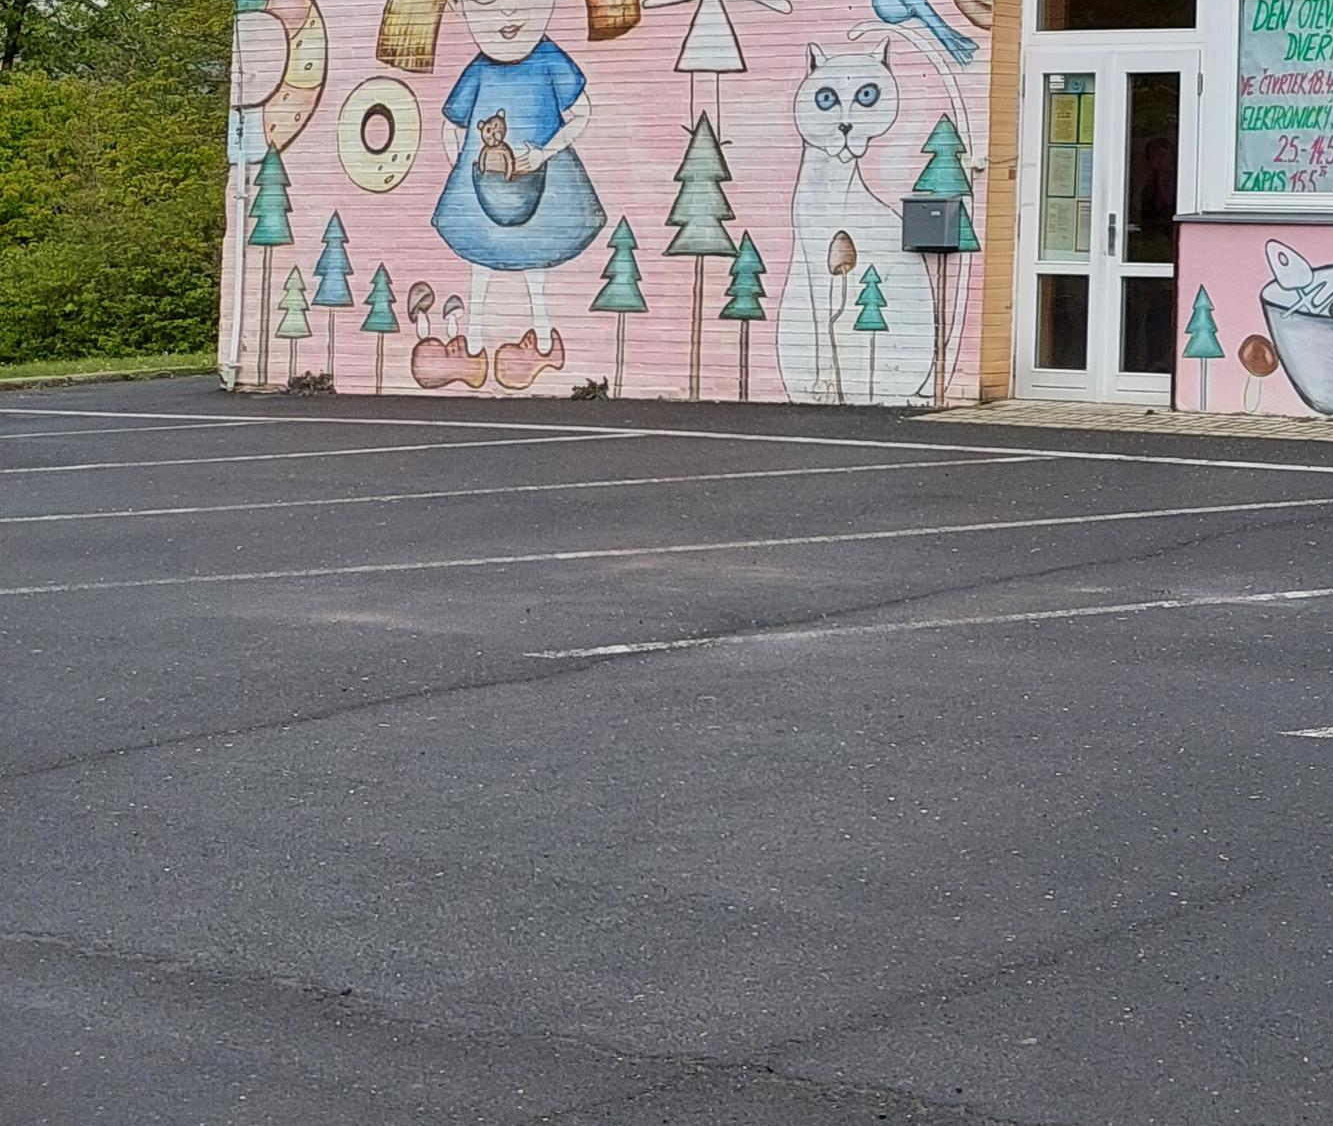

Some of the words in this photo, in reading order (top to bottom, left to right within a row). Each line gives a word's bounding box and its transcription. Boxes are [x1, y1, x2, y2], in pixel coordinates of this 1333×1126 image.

[1241, 75, 1256, 95] VE
[1259, 68, 1307, 95] ČTVRTEK
[1238, 165, 1286, 191] ZÁPIS
